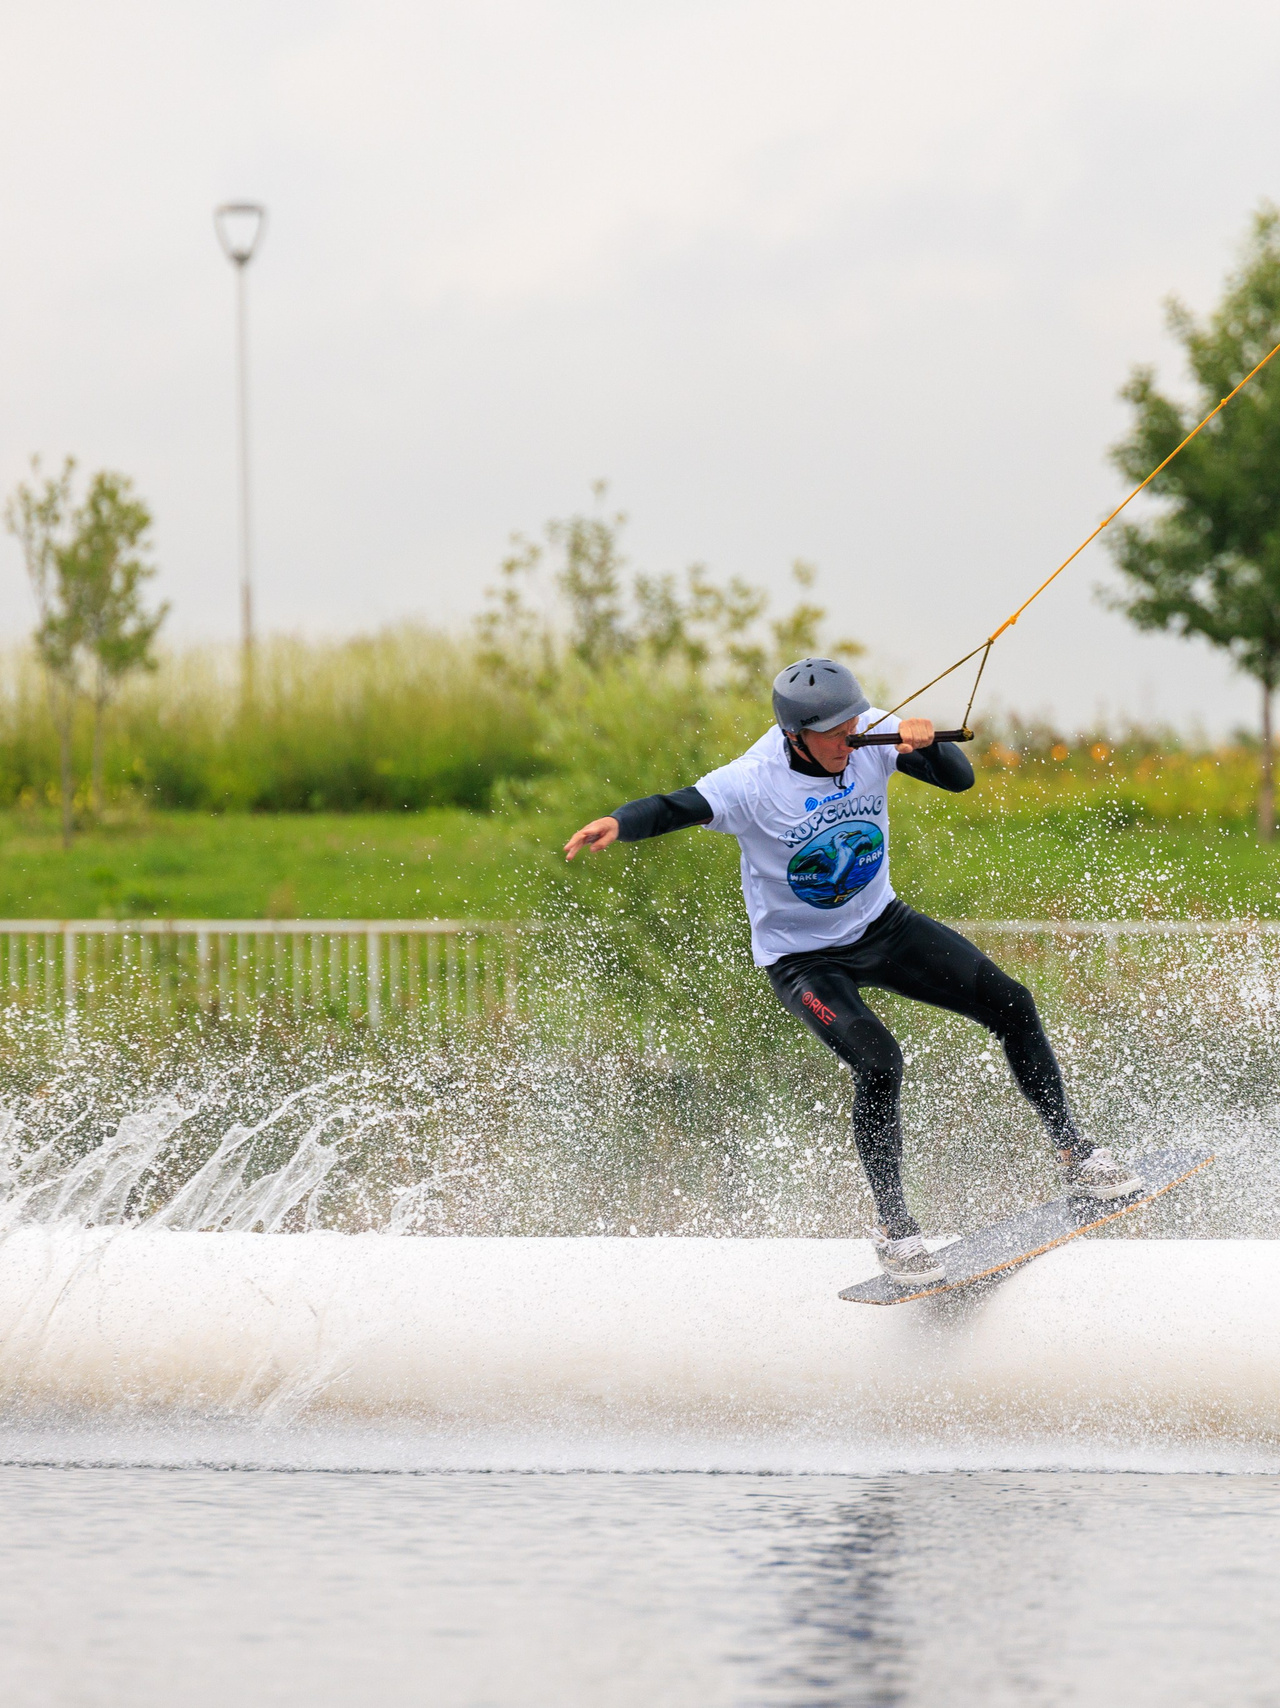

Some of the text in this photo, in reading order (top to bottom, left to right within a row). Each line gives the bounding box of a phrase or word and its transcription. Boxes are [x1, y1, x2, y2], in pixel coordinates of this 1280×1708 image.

[777, 795, 885, 848] KUPCHINO
[790, 847, 883, 882] WAKE PARK
